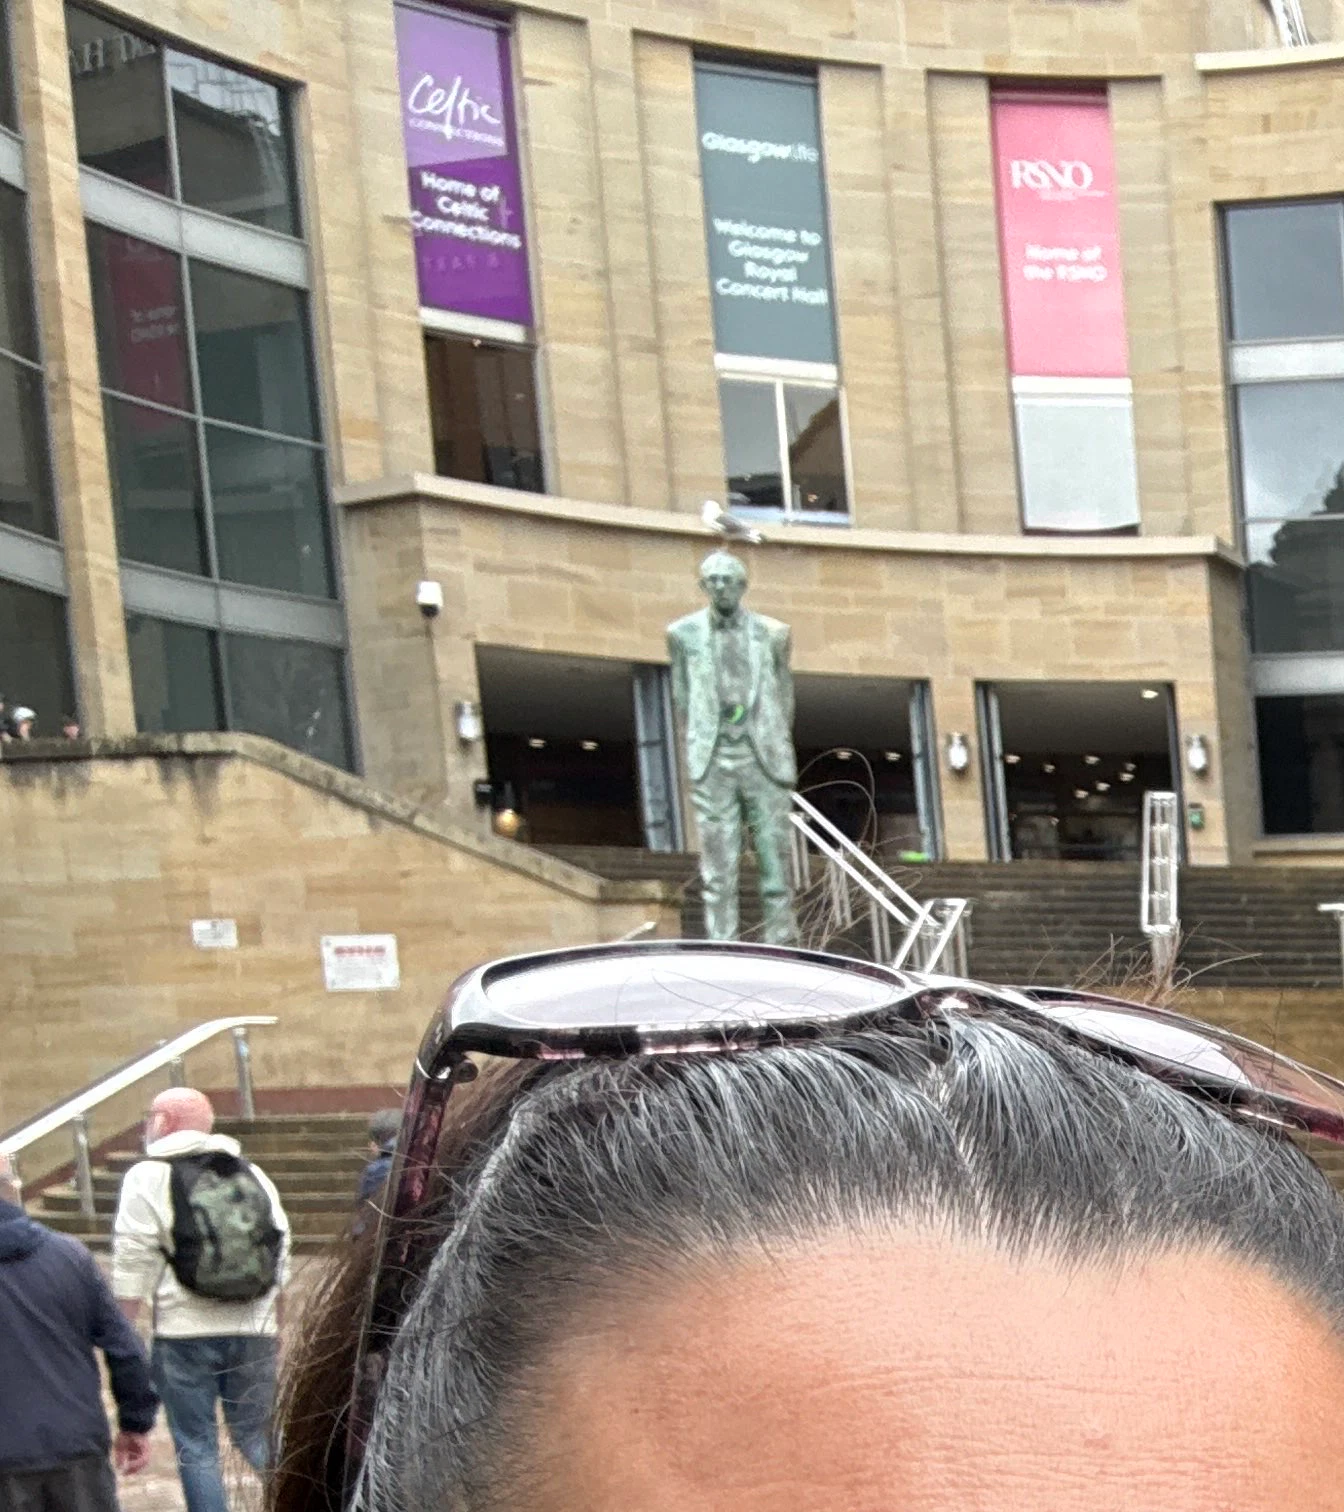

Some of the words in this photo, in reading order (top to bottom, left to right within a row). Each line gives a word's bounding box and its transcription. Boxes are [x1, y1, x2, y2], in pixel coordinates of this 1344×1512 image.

[408, 74, 501, 140] Celtic
[421, 171, 477, 198] Home
[479, 186, 500, 202] of
[1010, 159, 1094, 191] RSNO
[436, 196, 489, 221] Celtic
[410, 210, 522, 249] Connections
[713, 218, 797, 243] Welcome
[799, 229, 821, 246] to
[728, 240, 809, 265] Glasgow
[744, 261, 798, 283] Royal
[716, 278, 789, 303] Concert
[791, 286, 829, 305] Hall
